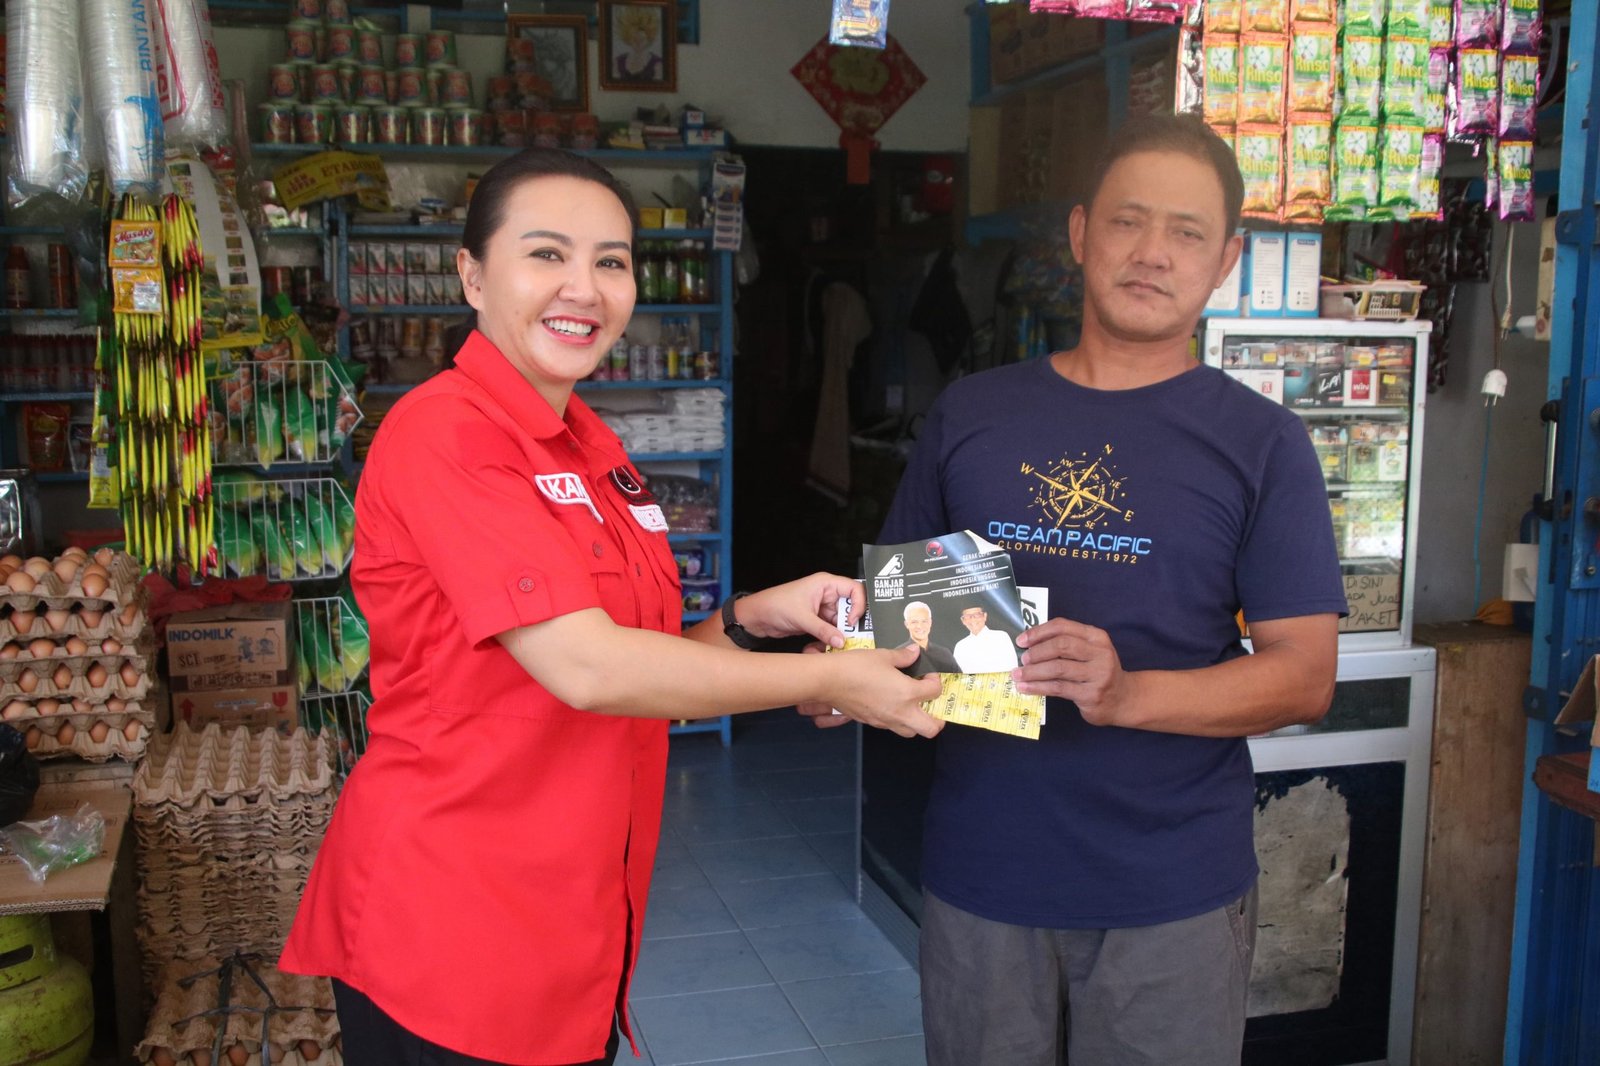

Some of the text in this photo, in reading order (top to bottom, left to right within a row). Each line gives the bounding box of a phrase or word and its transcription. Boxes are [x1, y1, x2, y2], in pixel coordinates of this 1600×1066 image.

[1296, 58, 1330, 71] Rinso
[1350, 63, 1381, 78] Rinso
[1393, 61, 1423, 77] Rinso
[1210, 69, 1238, 84] Rins
[1247, 66, 1282, 83] Rinso
[1465, 72, 1497, 89] Rinso
[1508, 78, 1535, 95] Rinso
[1344, 152, 1376, 167] Rinso
[1504, 165, 1531, 179] Rinso
[115, 227, 153, 243] Masako
[1021, 462, 1035, 476] W
[1124, 510, 1135, 522] E
[1085, 520, 1096, 530] SE
[989, 521, 1152, 555] OCEAN PACIFIC
[998, 540, 1067, 557] CLOTHING
[956, 561, 995, 574] INDONESIA RAYA
[874, 579, 904, 589] GANJAR
[950, 572, 997, 586] INDONESIA UNGGUL
[1360, 576, 1384, 590] SINI
[874, 587, 904, 598] MAHFUD
[943, 587, 970, 598] INDONESIA
[971, 585, 985, 594] LEBIH
[1346, 605, 1399, 628] PAKET
[168, 628, 234, 642] INDOMILK
